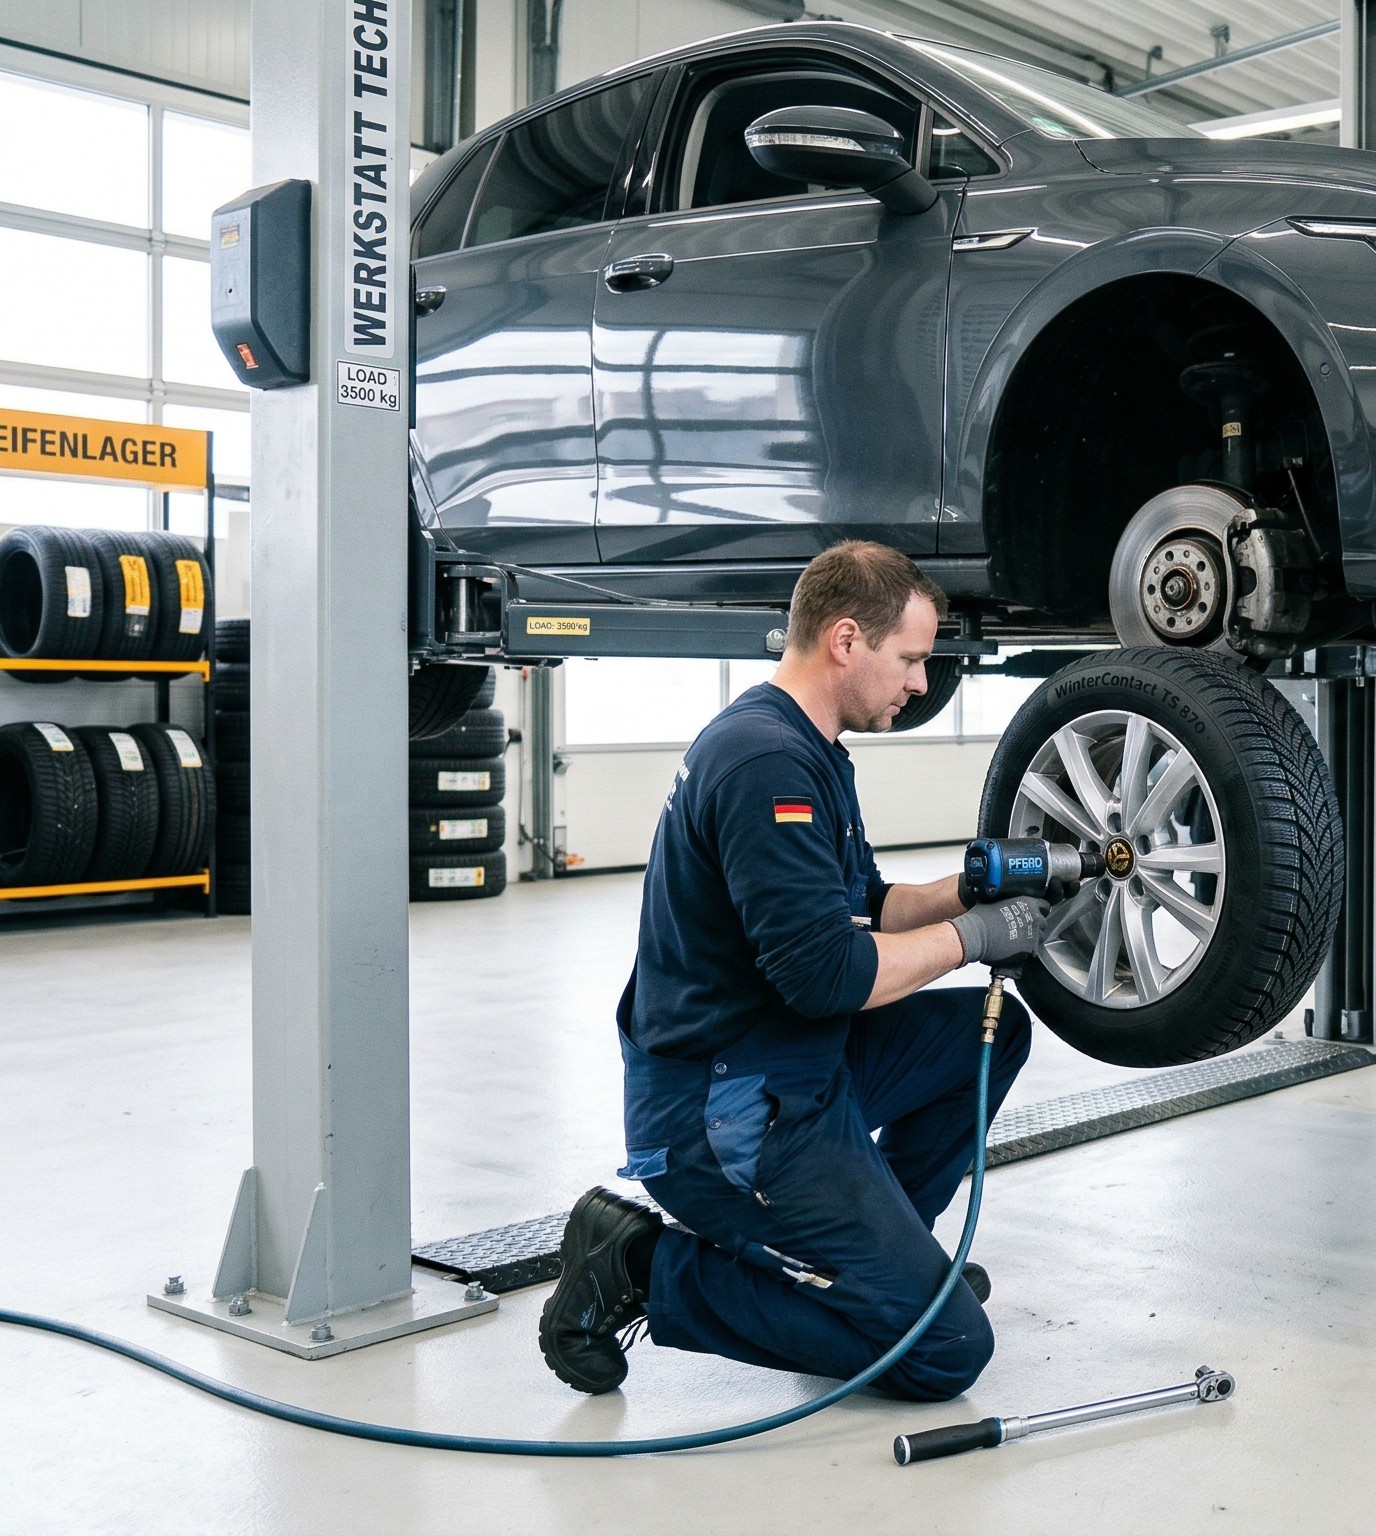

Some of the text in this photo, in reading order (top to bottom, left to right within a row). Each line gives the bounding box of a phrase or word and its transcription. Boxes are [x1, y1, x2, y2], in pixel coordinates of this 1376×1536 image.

[353, 0, 388, 346] WERKSTATT TECH
[340, 384, 397, 408] 3500 kg
[347, 366, 388, 386] LOAD
[1054, 672, 1206, 735] WinterContact TS 870
